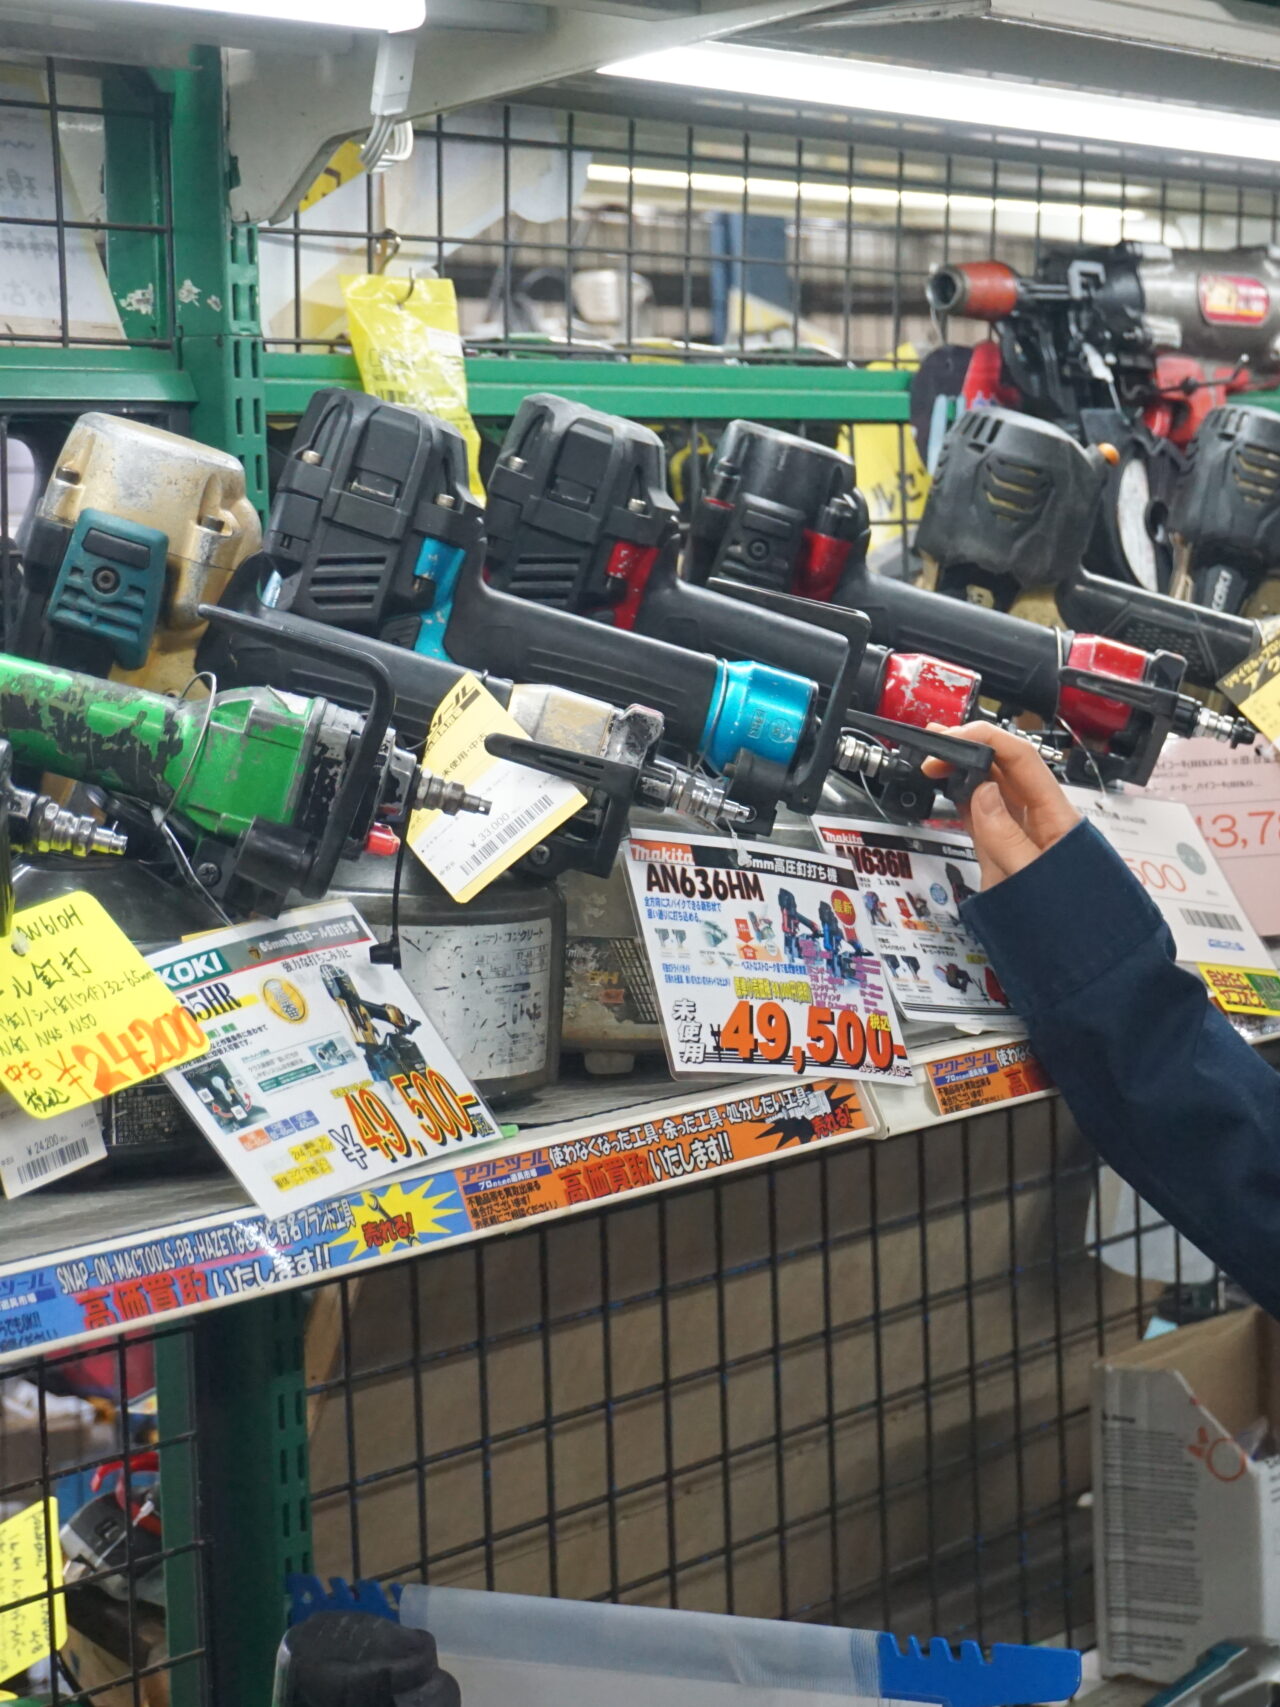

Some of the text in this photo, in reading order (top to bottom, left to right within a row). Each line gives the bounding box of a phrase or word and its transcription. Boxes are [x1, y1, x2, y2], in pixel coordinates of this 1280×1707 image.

[822, 829, 865, 846] makita
[632, 843, 694, 866] makita
[742, 853, 838, 883] 5mm高圧釘打ち機
[645, 863, 765, 902] AN636HM
[157, 951, 224, 989] KOKI
[672, 998, 707, 1065] 未使用
[869, 1013, 892, 1032] 税込
[931, 1052, 995, 1077] アクトツール
[34, 1134, 60, 1155] 24,200
[462, 1151, 549, 1184] アクトツール
[361, 1212, 415, 1249] 売れる!
